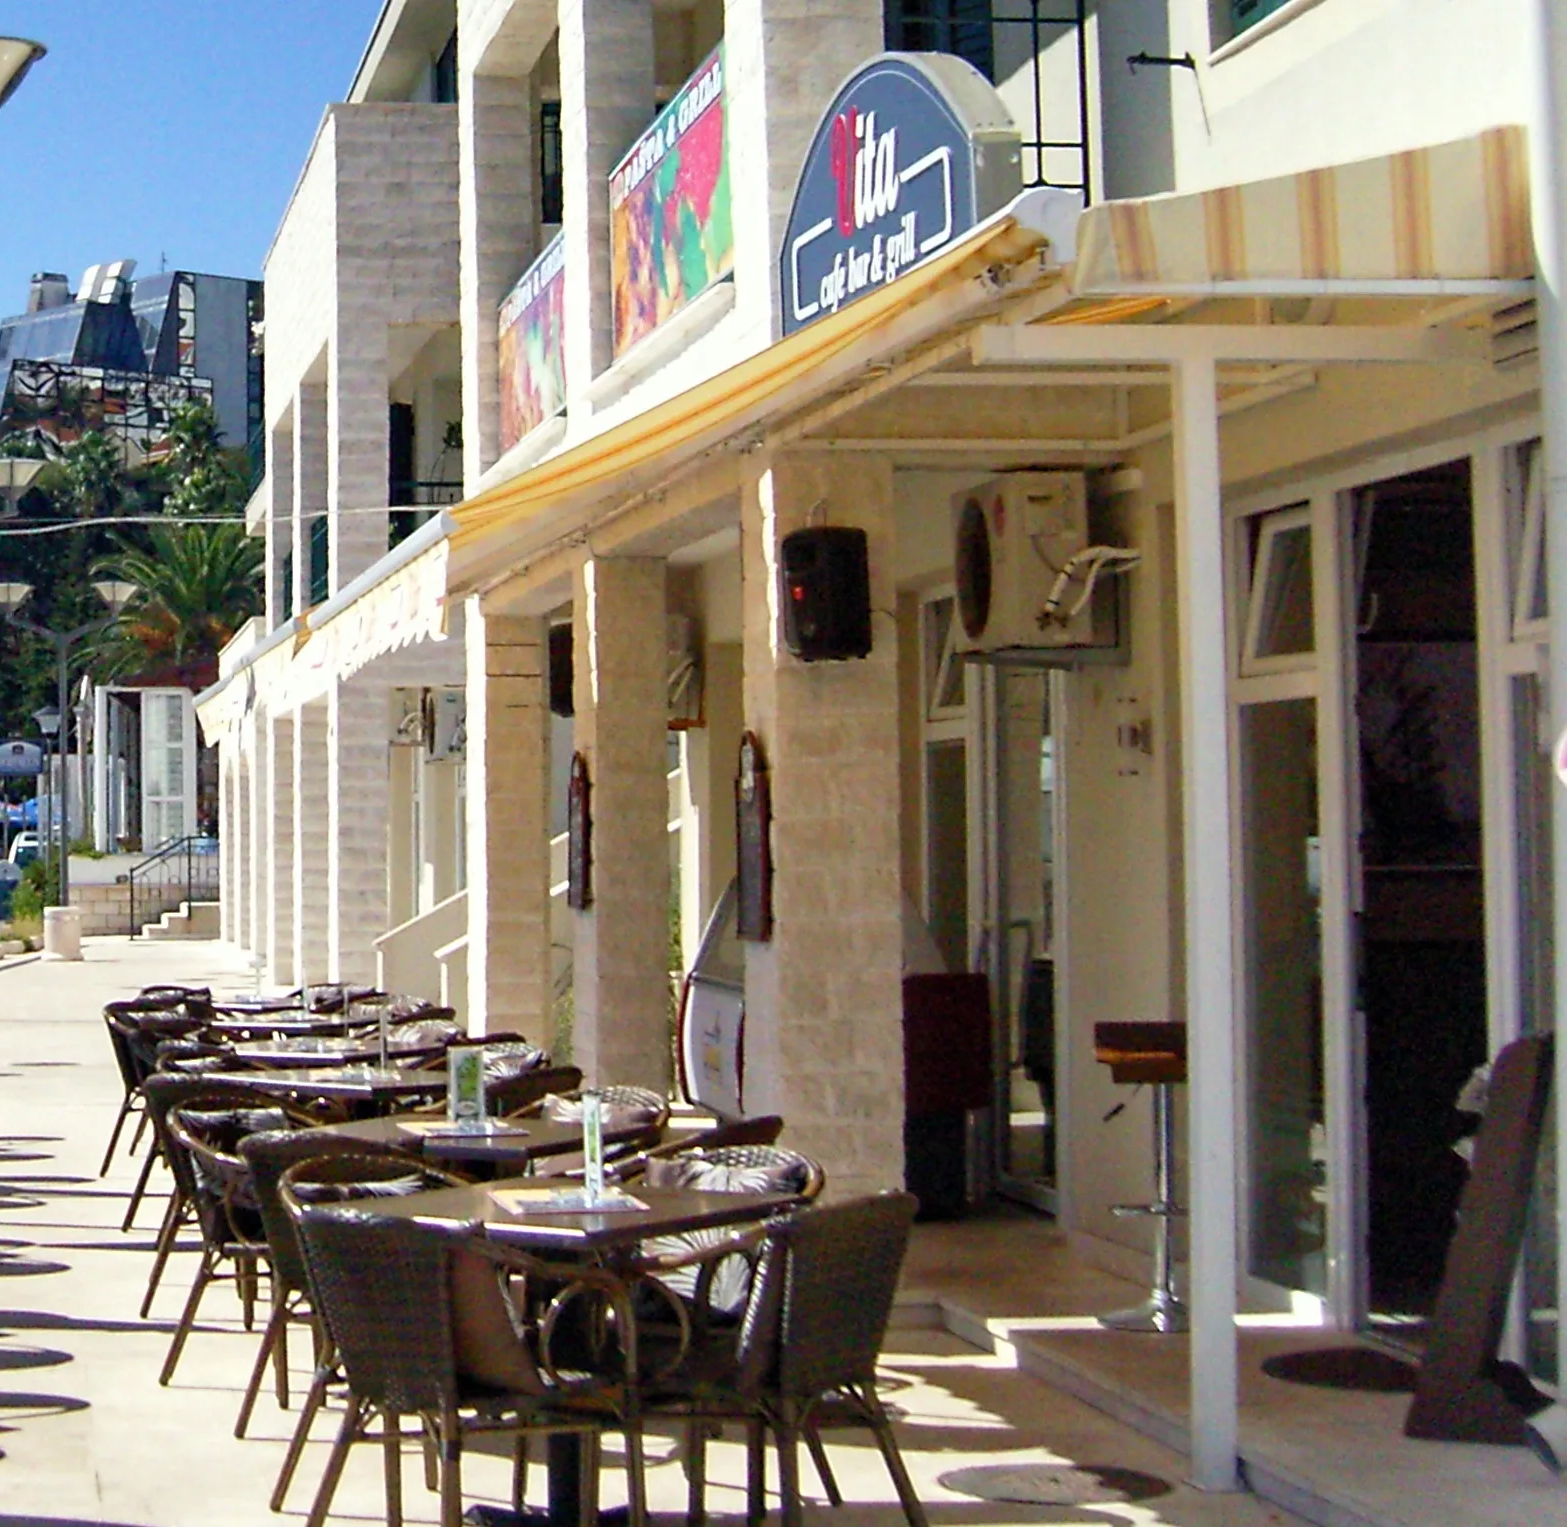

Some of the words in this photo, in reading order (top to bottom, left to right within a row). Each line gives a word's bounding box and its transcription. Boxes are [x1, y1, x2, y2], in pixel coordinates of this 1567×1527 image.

[677, 61, 722, 133] GRILL
[832, 105, 899, 237] Vita
[848, 246, 871, 292] bar
[871, 234, 883, 282] &
[886, 211, 915, 284] grill
